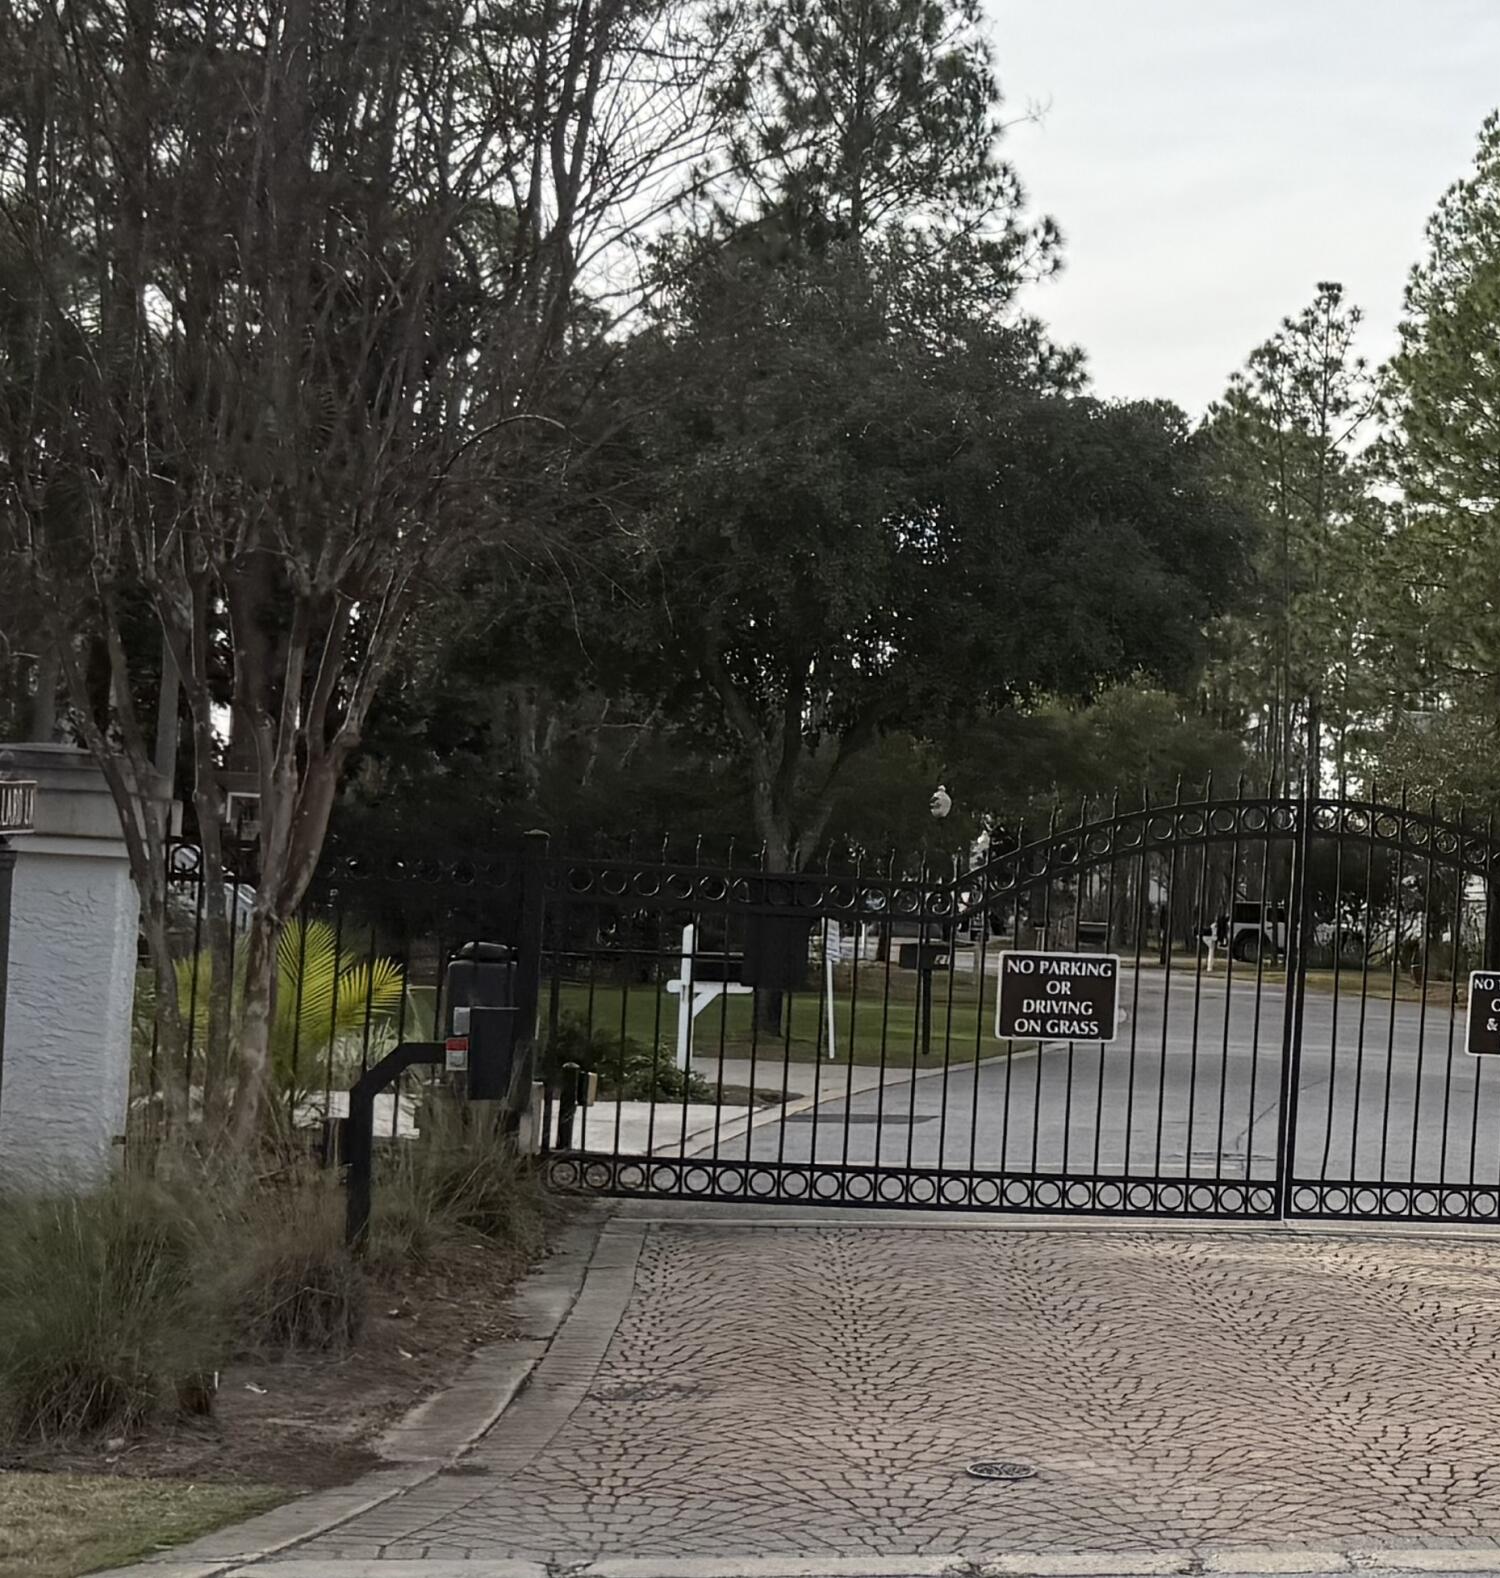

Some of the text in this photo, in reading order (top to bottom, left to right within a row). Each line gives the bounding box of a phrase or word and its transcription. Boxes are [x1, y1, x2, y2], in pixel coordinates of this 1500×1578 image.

[1007, 959, 1112, 977] NO PARKING
[1046, 980, 1071, 994] OR
[1474, 979, 1494, 990] NO
[1022, 999, 1093, 1015] DRIVING
[1014, 1018, 1099, 1035] ON GRASS
[1486, 1018, 1498, 1031] &
